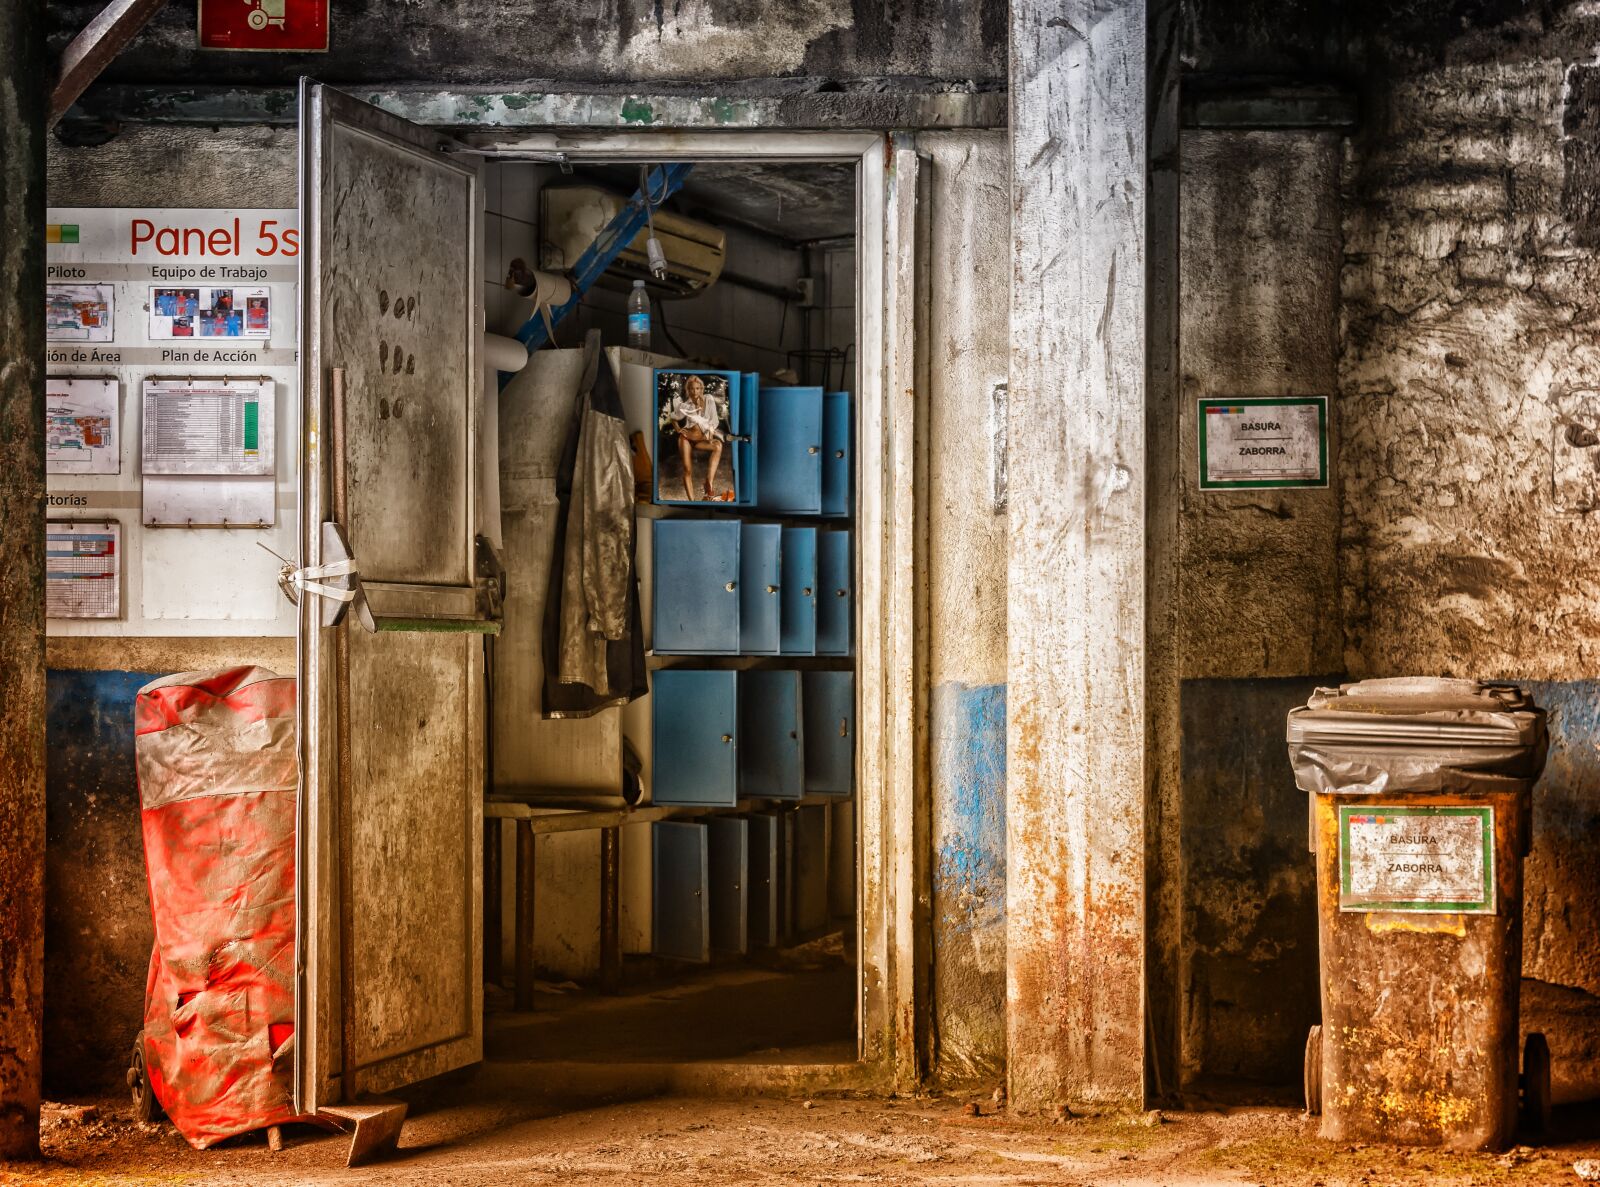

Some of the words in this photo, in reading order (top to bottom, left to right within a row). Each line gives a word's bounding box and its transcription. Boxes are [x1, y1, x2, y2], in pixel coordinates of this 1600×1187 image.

[131, 217, 240, 256] Panel
[256, 220, 299, 256] 5s
[48, 265, 86, 278] Piloto
[152, 266, 196, 280] Equipo
[199, 266, 216, 278] de
[219, 266, 268, 281] Trabajo
[71, 349, 87, 362] de
[91, 348, 121, 362] Área
[162, 350, 189, 362] Plan
[193, 350, 210, 362] de
[213, 350, 257, 362] Acción
[1241, 422, 1281, 431] BASURA
[1239, 446, 1286, 456] ZABORRA
[1390, 835, 1437, 845] BASURA
[1388, 863, 1443, 873] ZABORRA
